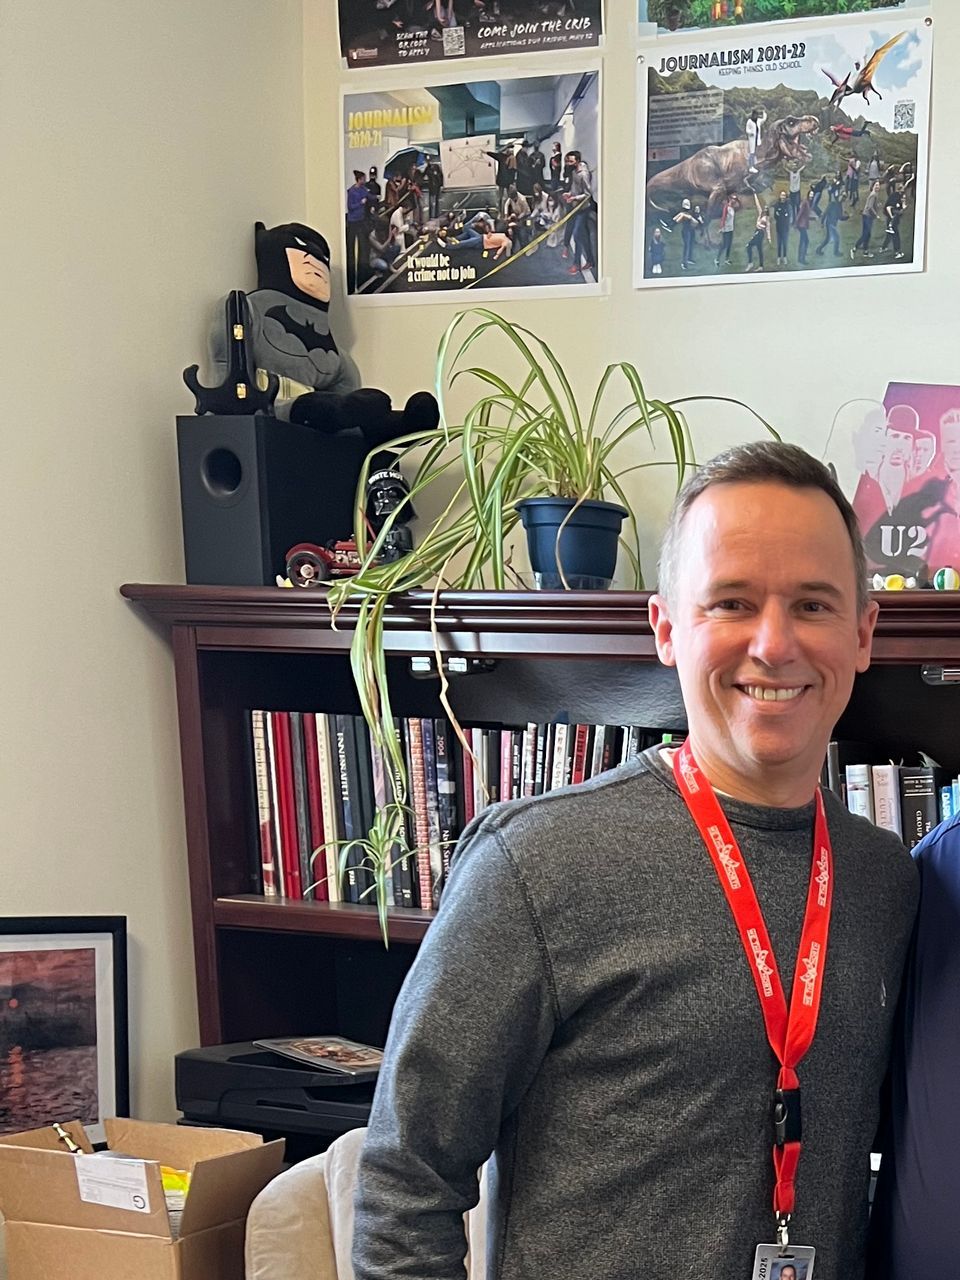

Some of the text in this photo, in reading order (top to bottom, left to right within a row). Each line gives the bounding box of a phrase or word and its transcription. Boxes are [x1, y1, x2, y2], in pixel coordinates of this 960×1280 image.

[478, 17, 591, 38] COME JOIN THE CRIB
[659, 42, 806, 73] JOURNALISM 2021-22
[718, 60, 802, 76] KEEPING THINGS OLD SCHOOL
[348, 104, 435, 130] JOURNALISM
[348, 132, 382, 148] 2020-21
[413, 254, 439, 268] would
[440, 253, 450, 267] be
[408, 266, 476, 282] a crime not to join
[880, 524, 928, 558] U2
